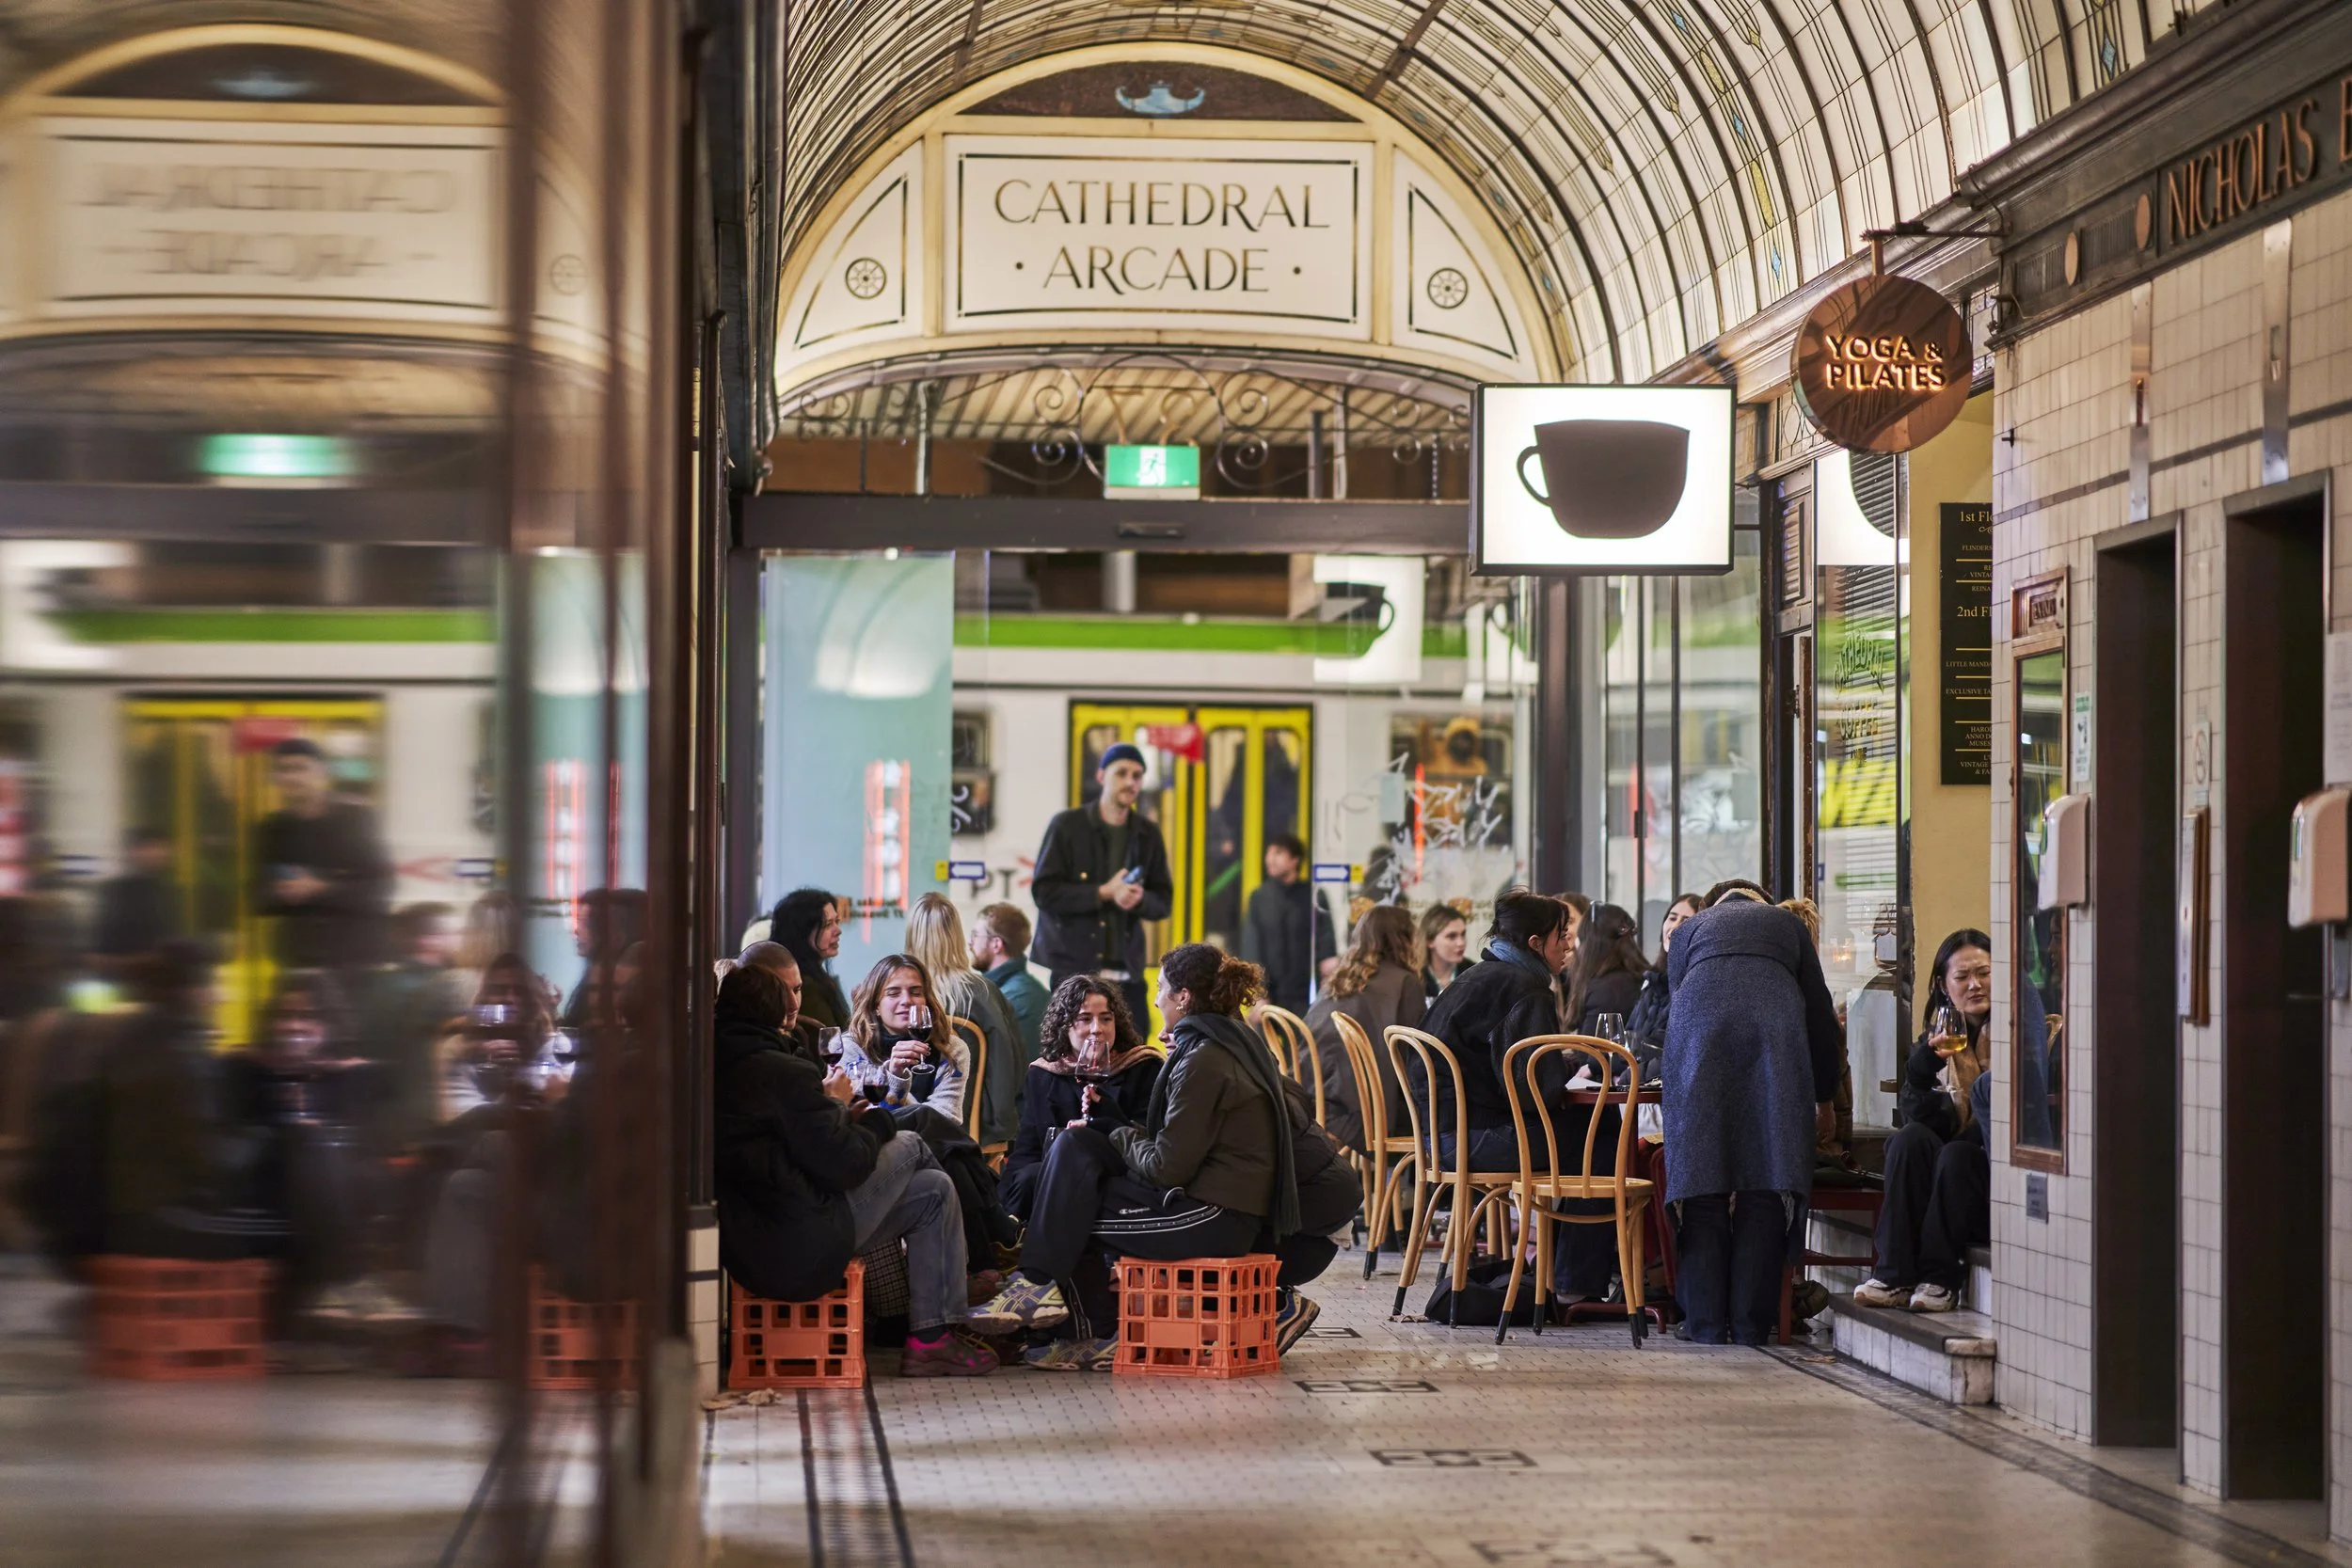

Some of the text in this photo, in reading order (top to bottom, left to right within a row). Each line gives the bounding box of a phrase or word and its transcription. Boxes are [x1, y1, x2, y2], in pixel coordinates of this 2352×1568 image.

[2168, 98, 2316, 245] NICHOLAS
[993, 178, 1331, 232] CATHEDRAL
[1042, 245, 1269, 295] ARCADE
[1825, 335, 1944, 364] YOGA &
[1825, 362, 1948, 391] PILATES
[1960, 511, 1975, 522] 1st
[1957, 606, 1978, 617] 2nd
